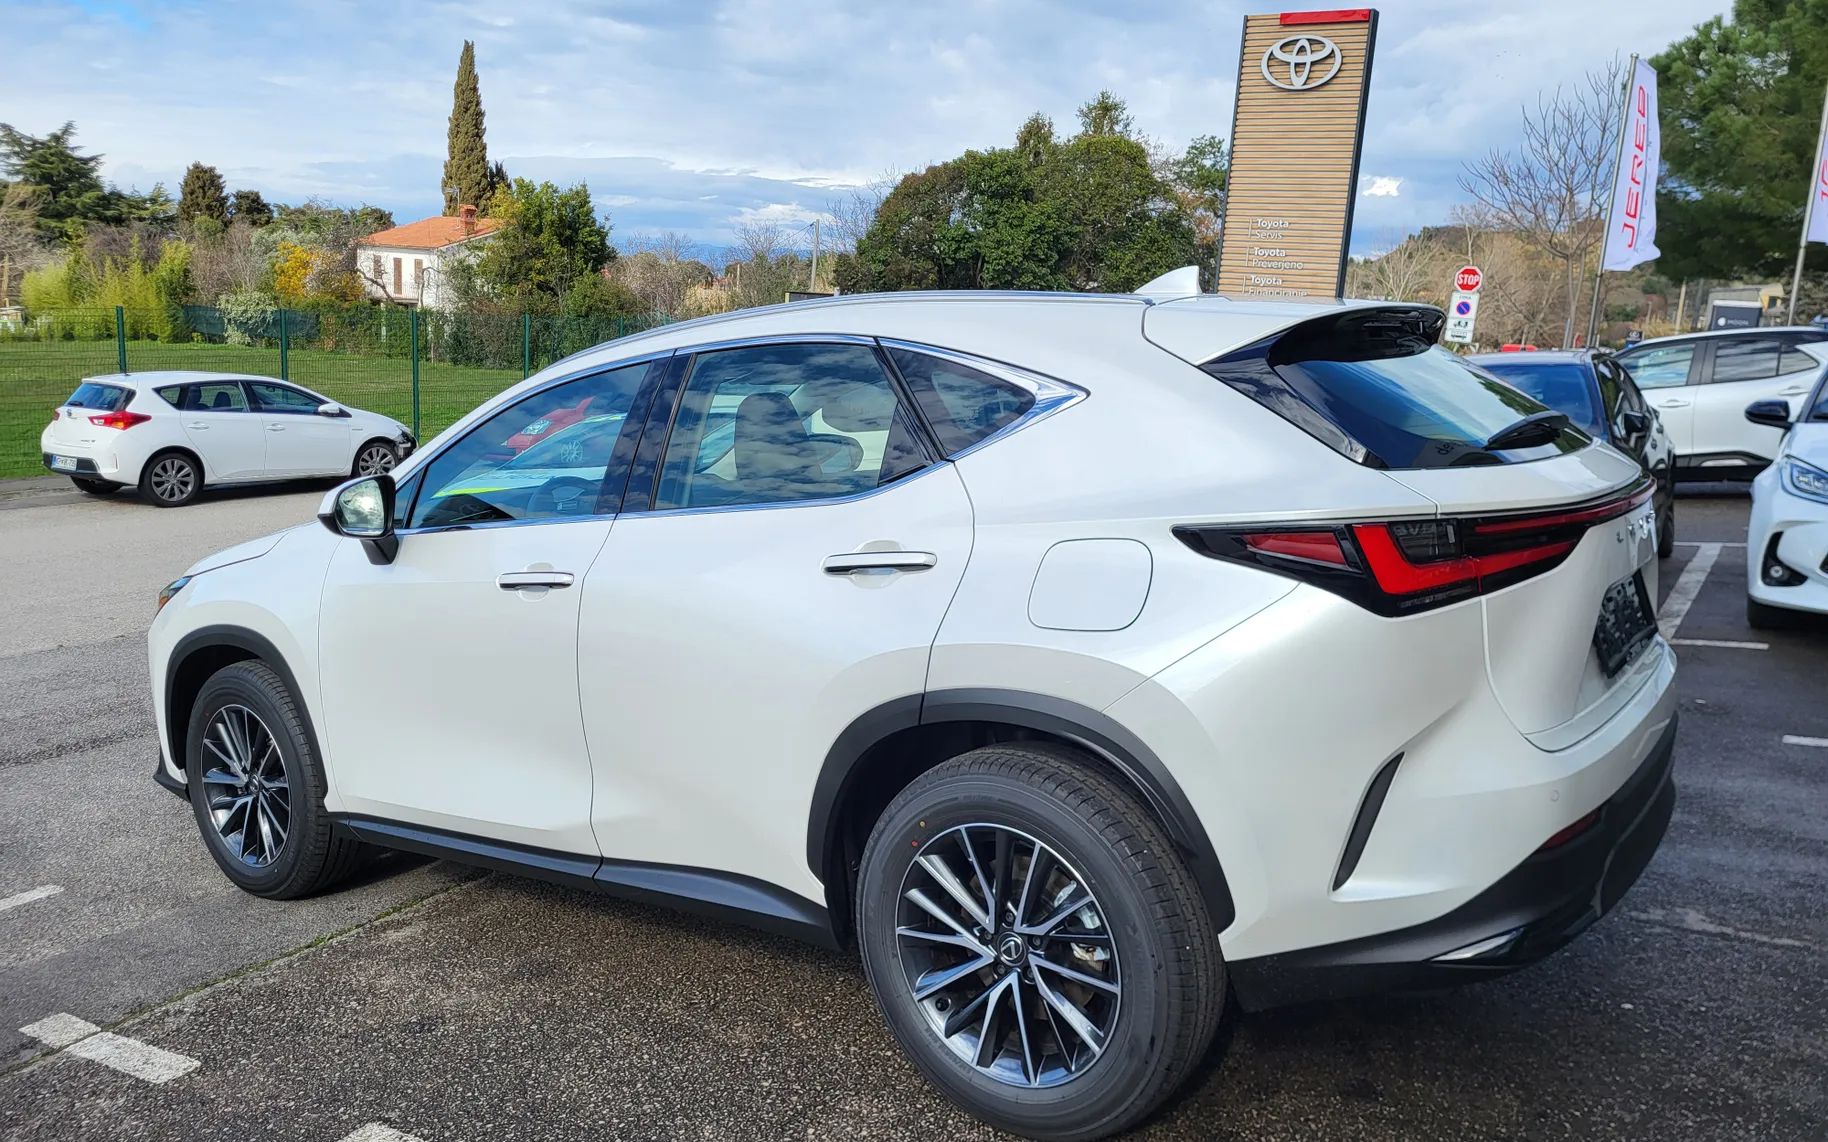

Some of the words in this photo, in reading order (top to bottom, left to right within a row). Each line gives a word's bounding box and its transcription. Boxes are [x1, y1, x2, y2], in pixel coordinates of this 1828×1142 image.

[1621, 85, 1646, 248] JEREB
[1256, 218, 1289, 229] Toyota
[1255, 230, 1283, 239] Servis
[1253, 247, 1286, 258] Toyota
[1252, 258, 1304, 270] Preverjeno
[1250, 275, 1282, 286] Toyota
[1457, 273, 1480, 285] STOP
